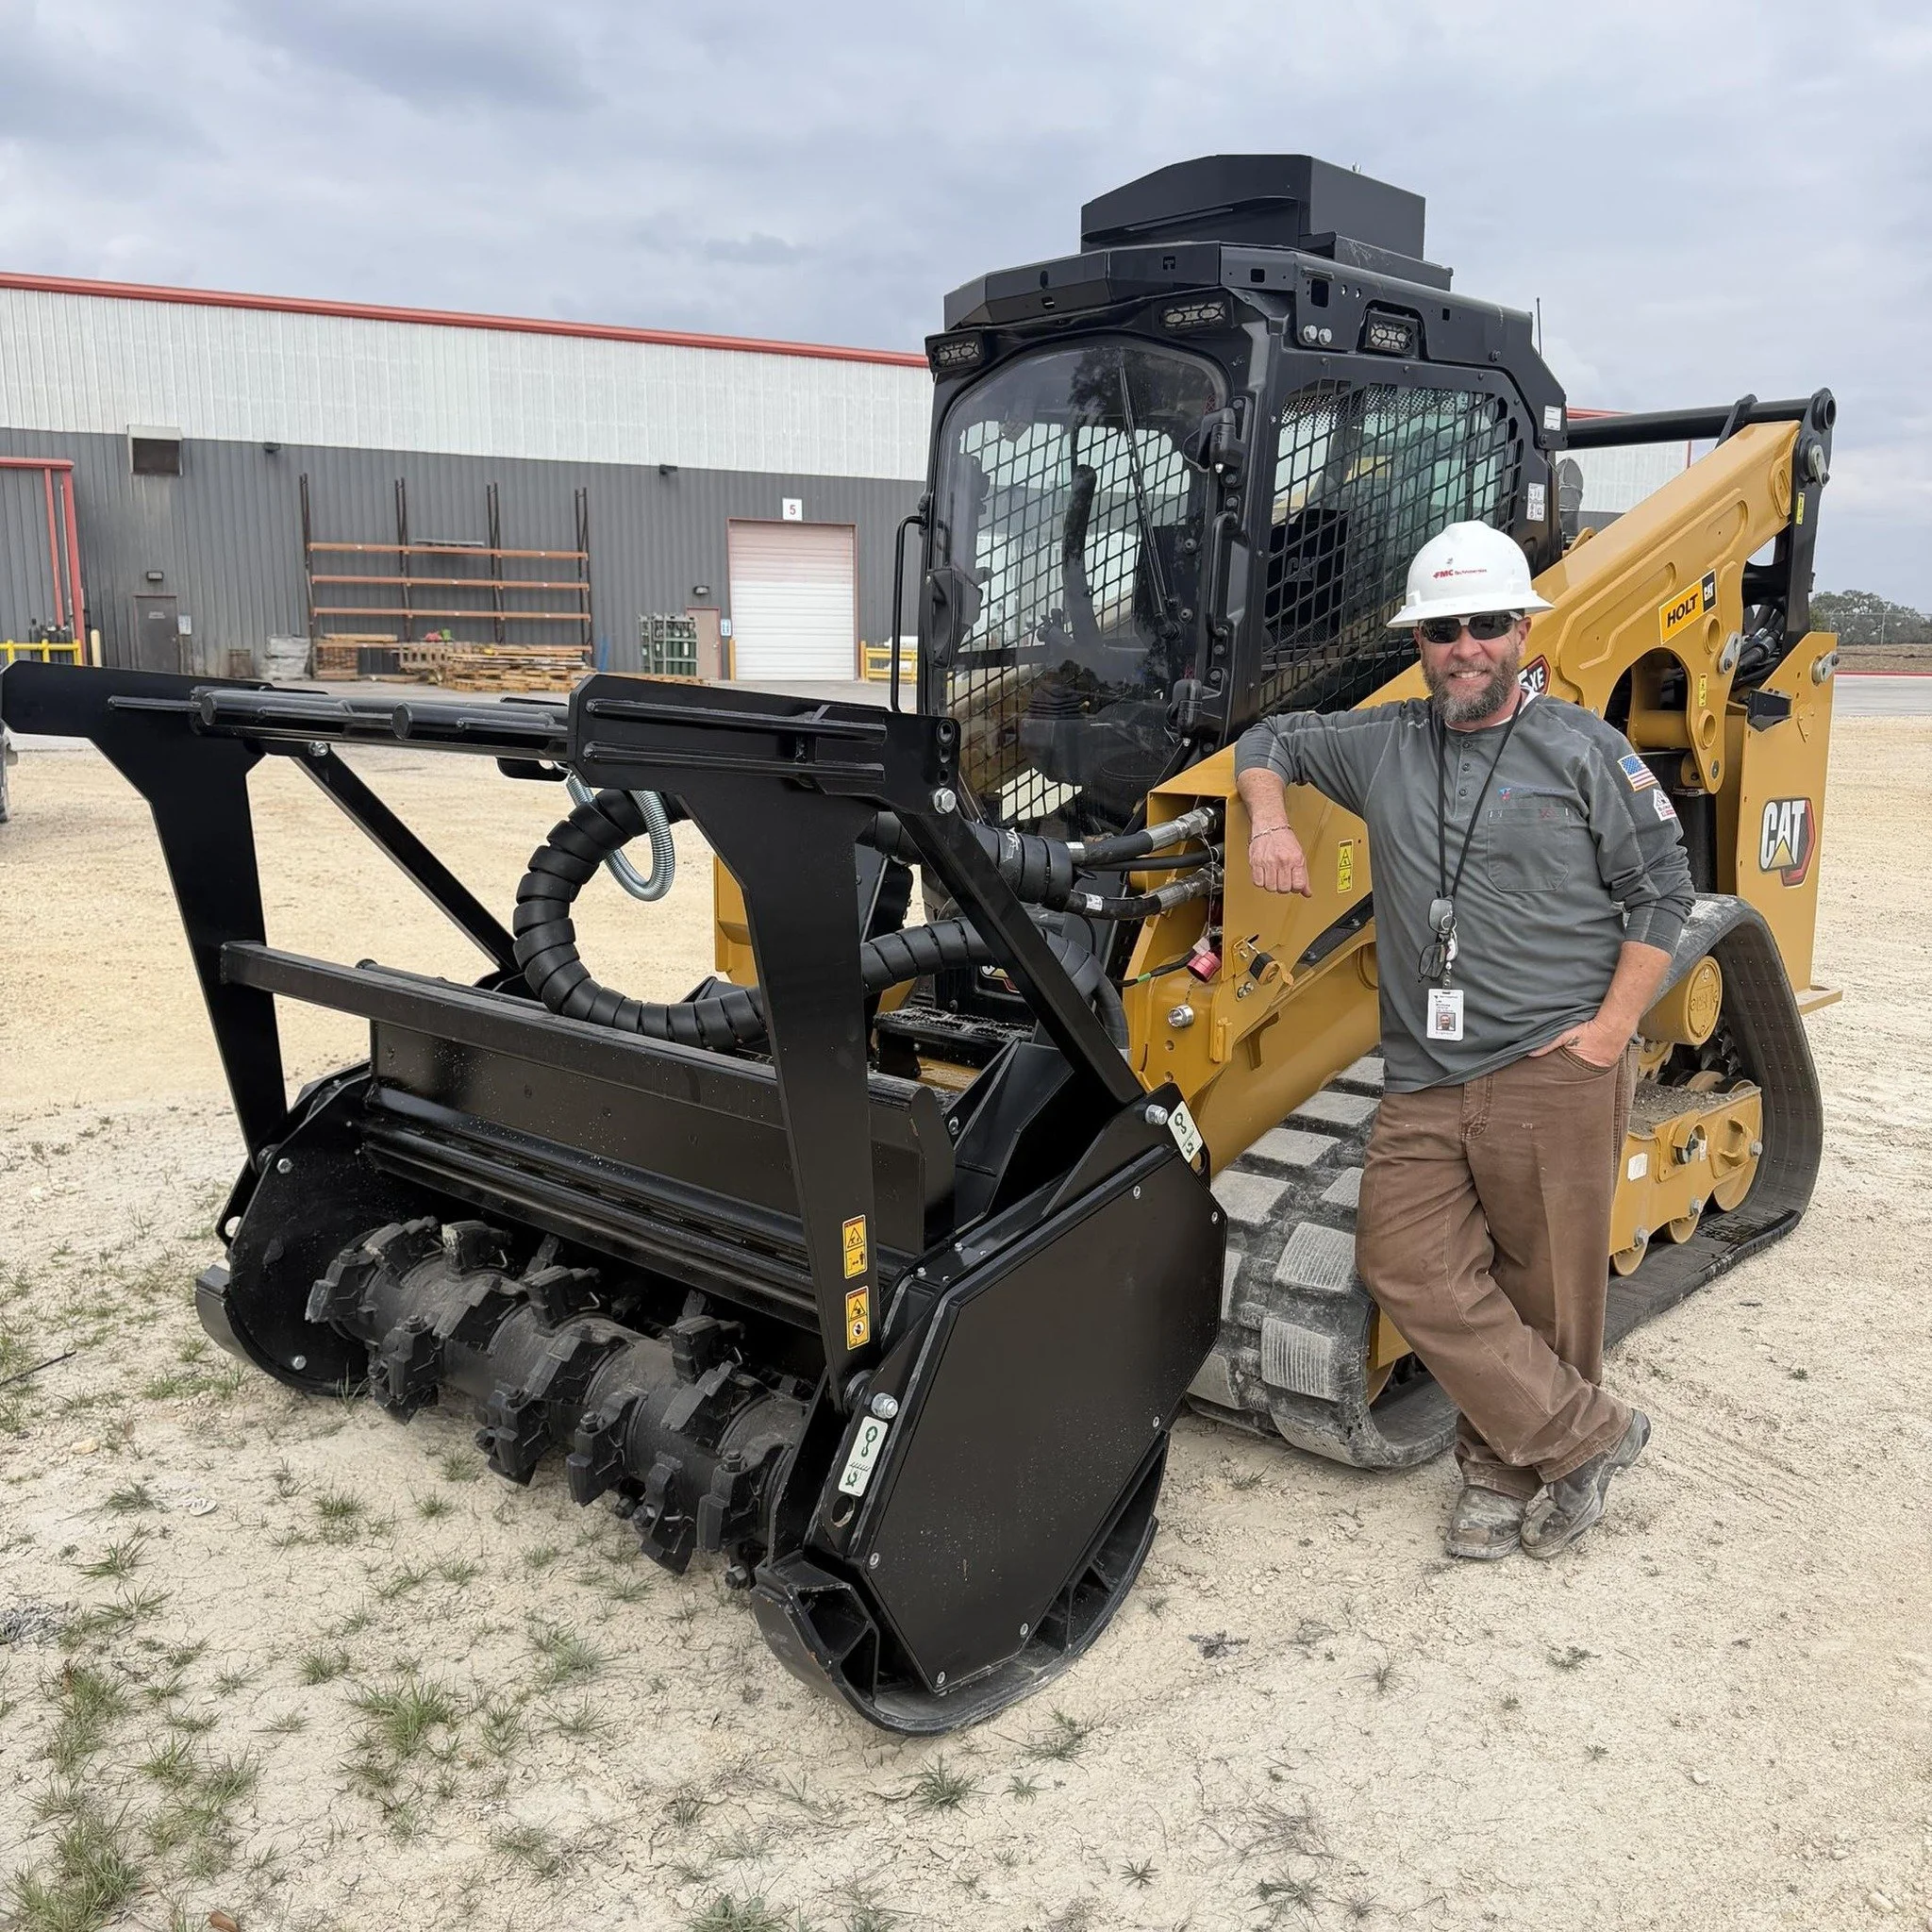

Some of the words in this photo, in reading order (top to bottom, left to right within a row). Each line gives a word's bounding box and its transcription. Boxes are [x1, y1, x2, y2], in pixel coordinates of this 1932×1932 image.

[789, 504, 796, 515] 5
[1433, 569, 1454, 578] FMC
[1667, 592, 1698, 628] HOLT
[1704, 581, 1715, 602] CAT
[1759, 799, 1807, 870] CAT
